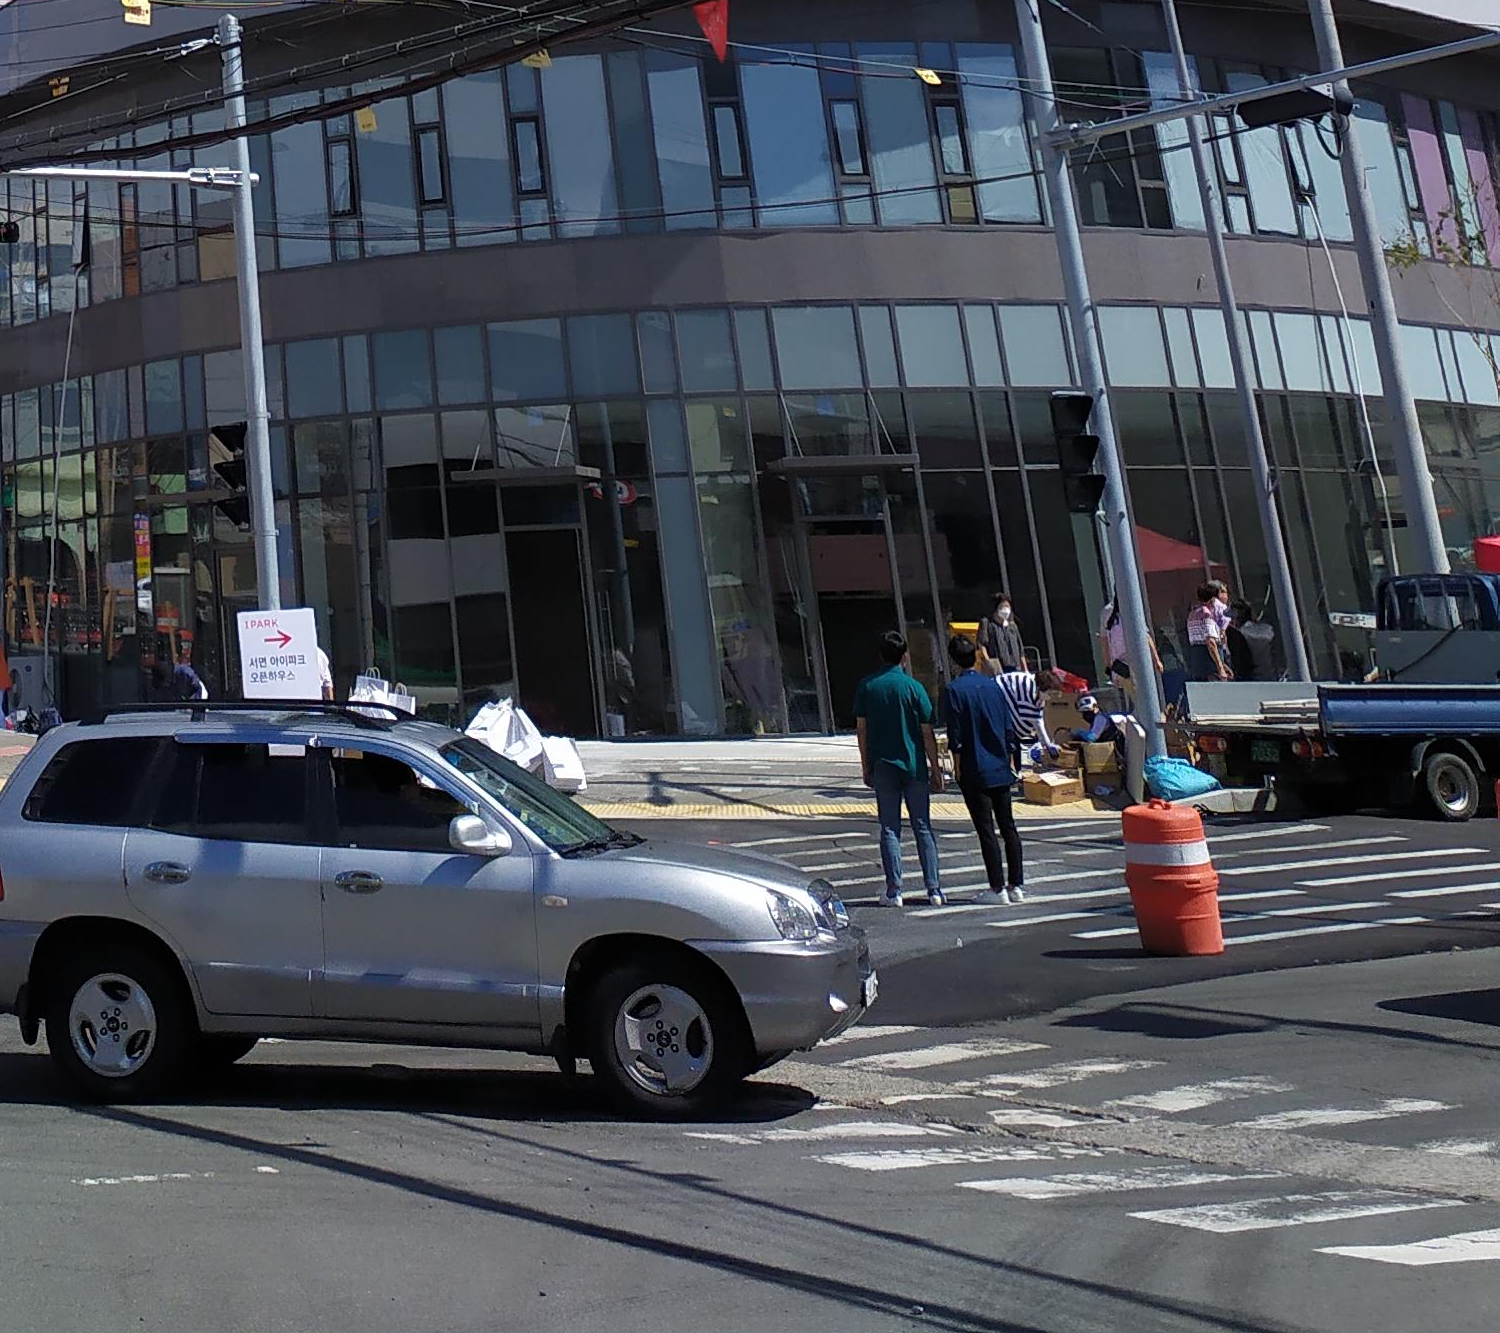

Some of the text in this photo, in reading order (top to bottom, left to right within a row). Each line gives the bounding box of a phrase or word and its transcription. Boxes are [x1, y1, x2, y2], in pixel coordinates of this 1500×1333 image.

[245, 619, 278, 629] IPARK
[250, 654, 306, 668] 서면 아이파크
[250, 670, 295, 683] 오픈하우스
